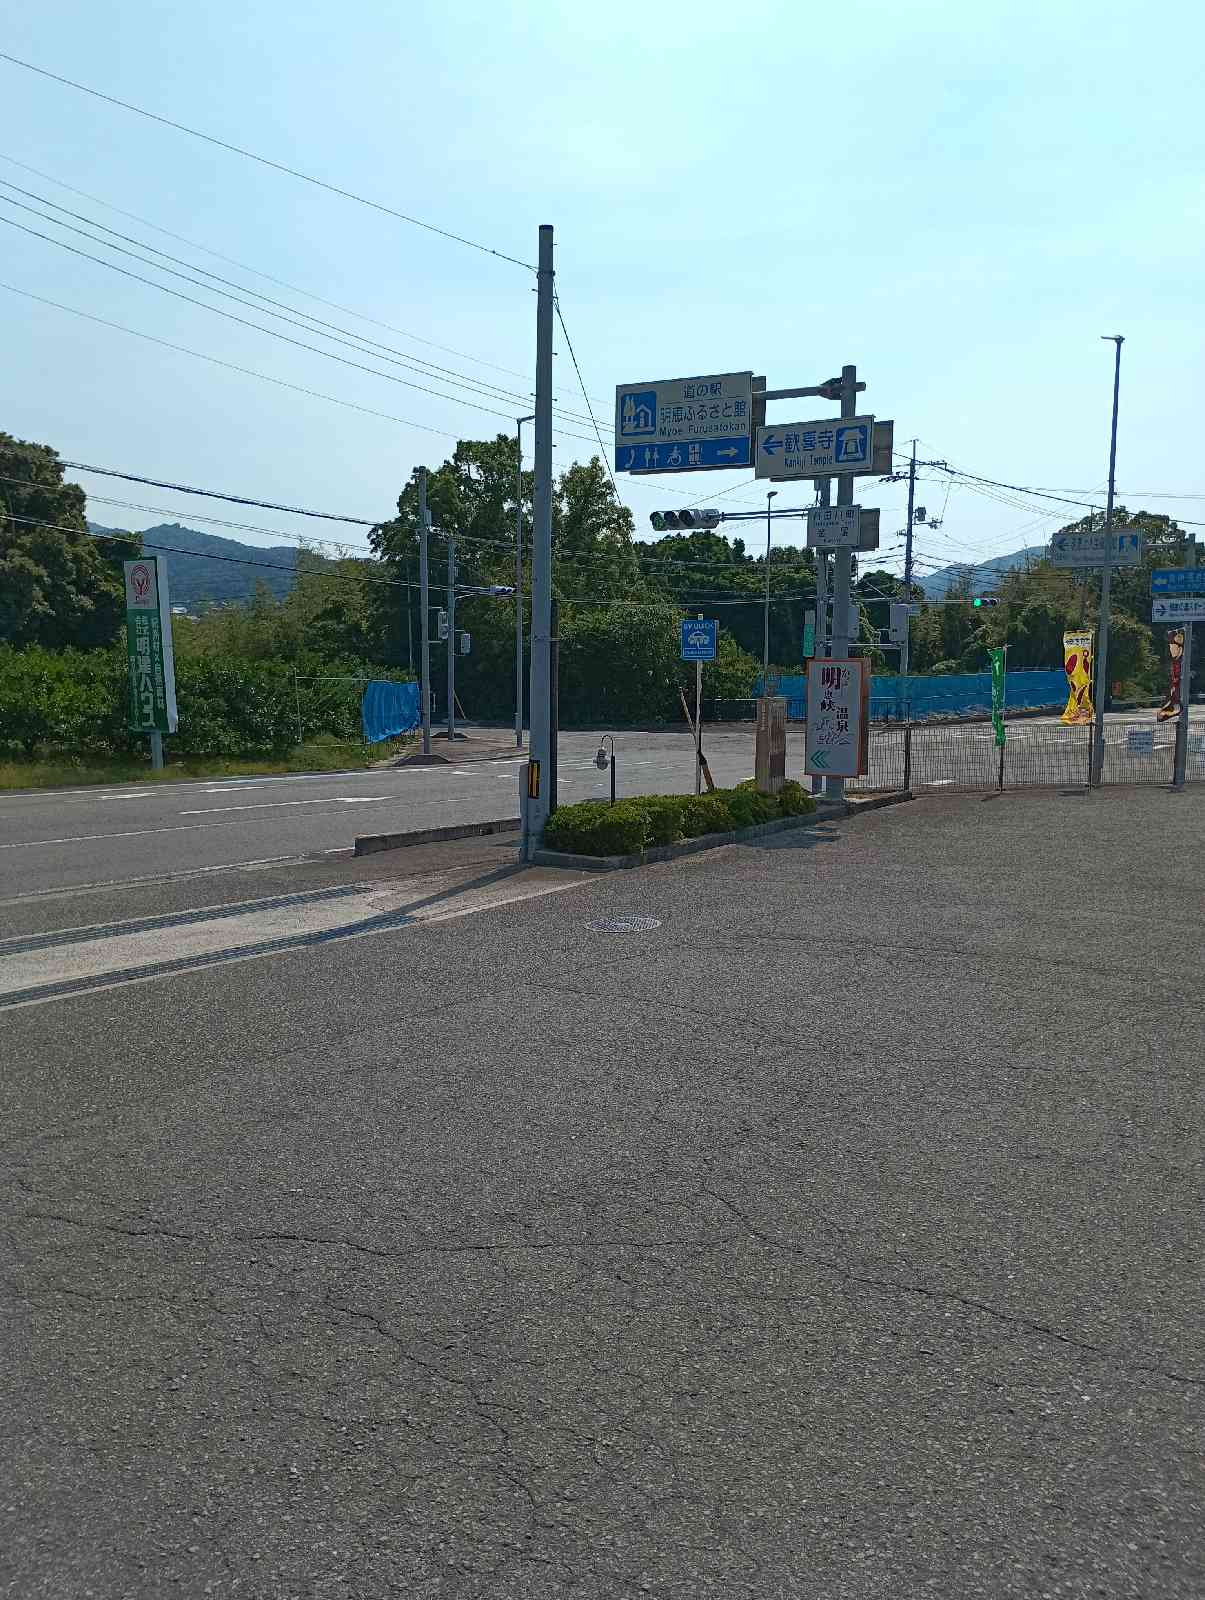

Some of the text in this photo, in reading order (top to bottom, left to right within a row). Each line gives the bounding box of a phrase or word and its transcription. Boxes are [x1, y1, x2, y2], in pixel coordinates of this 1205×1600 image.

[683, 382, 722, 400] 道の駅
[688, 422, 746, 434] Furusatokan
[810, 454, 833, 466] Temple
[836, 706, 849, 733] 温泉
